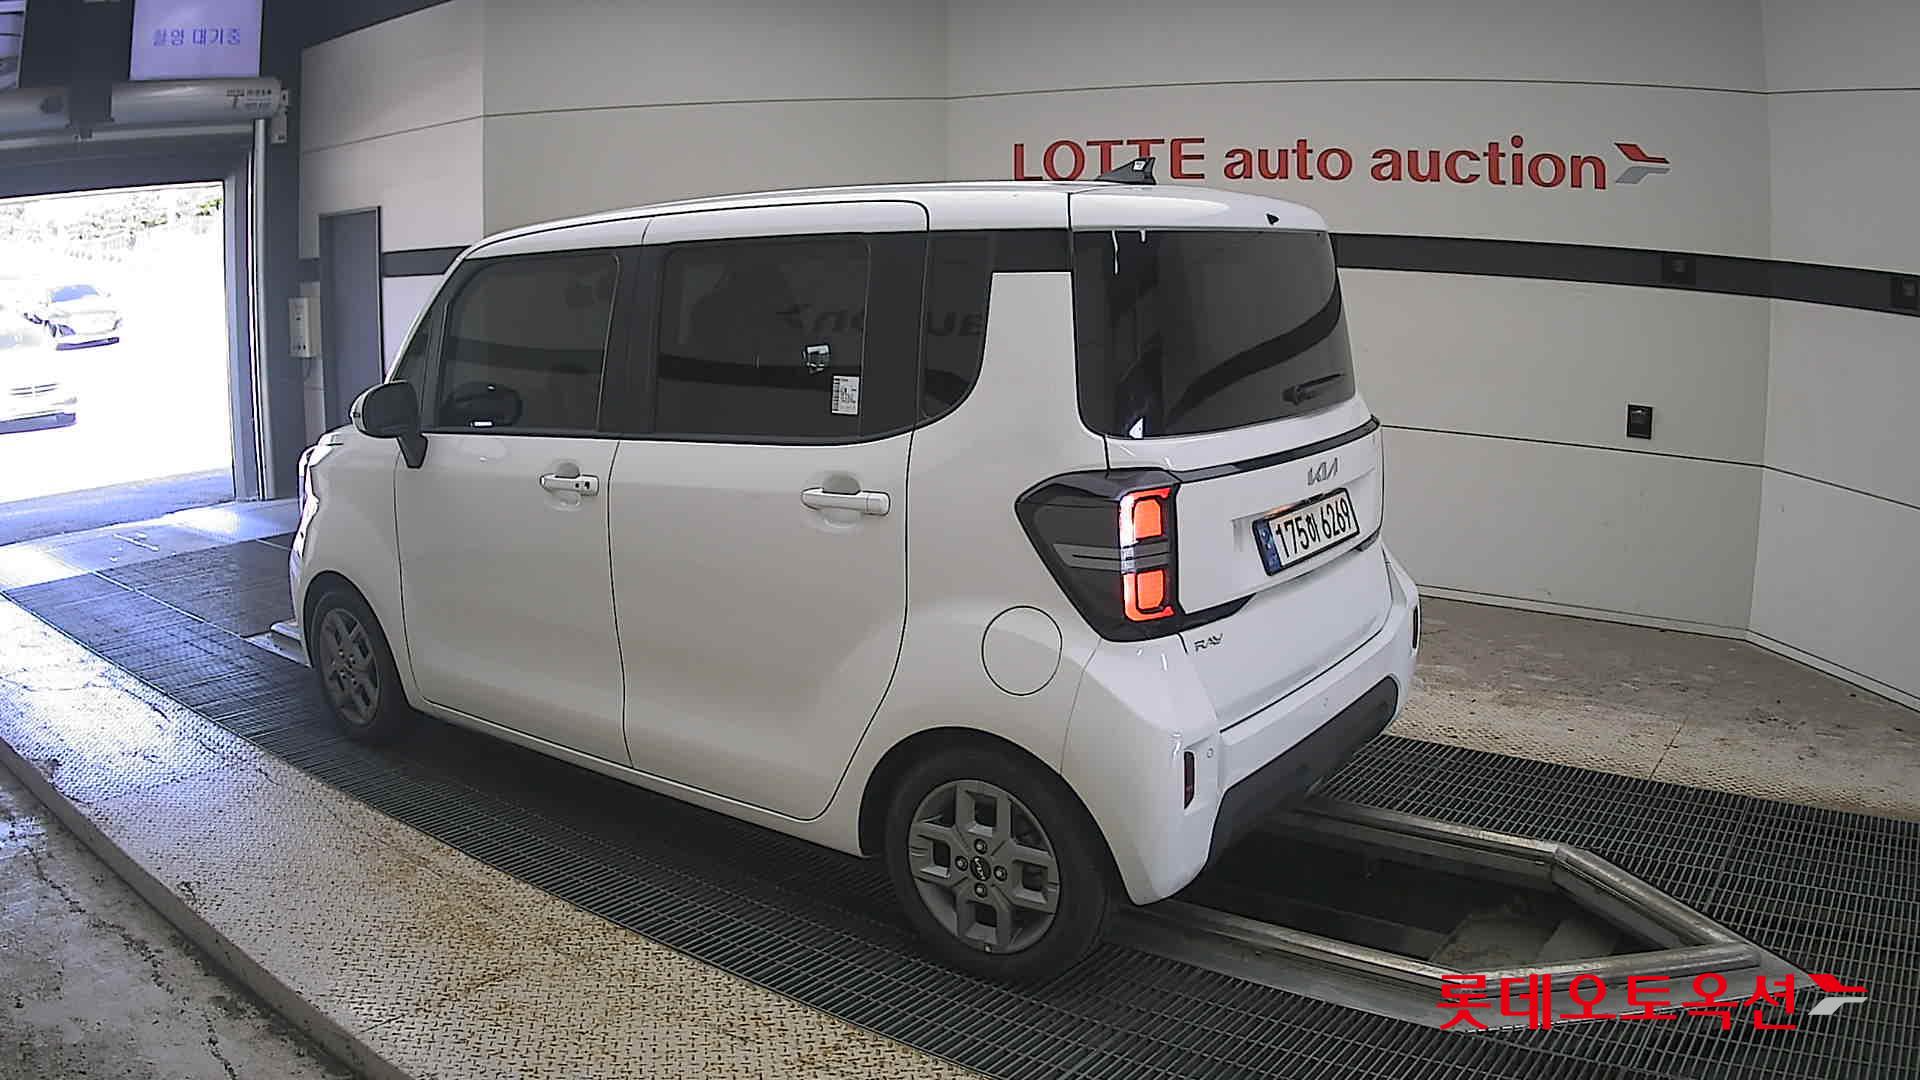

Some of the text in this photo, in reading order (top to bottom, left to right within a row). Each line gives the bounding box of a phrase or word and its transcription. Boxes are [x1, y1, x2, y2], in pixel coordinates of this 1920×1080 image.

[1013, 135, 1606, 190] LOTTE auto auction
[1320, 498, 1352, 539] 6269
[1194, 633, 1223, 652] RAY
